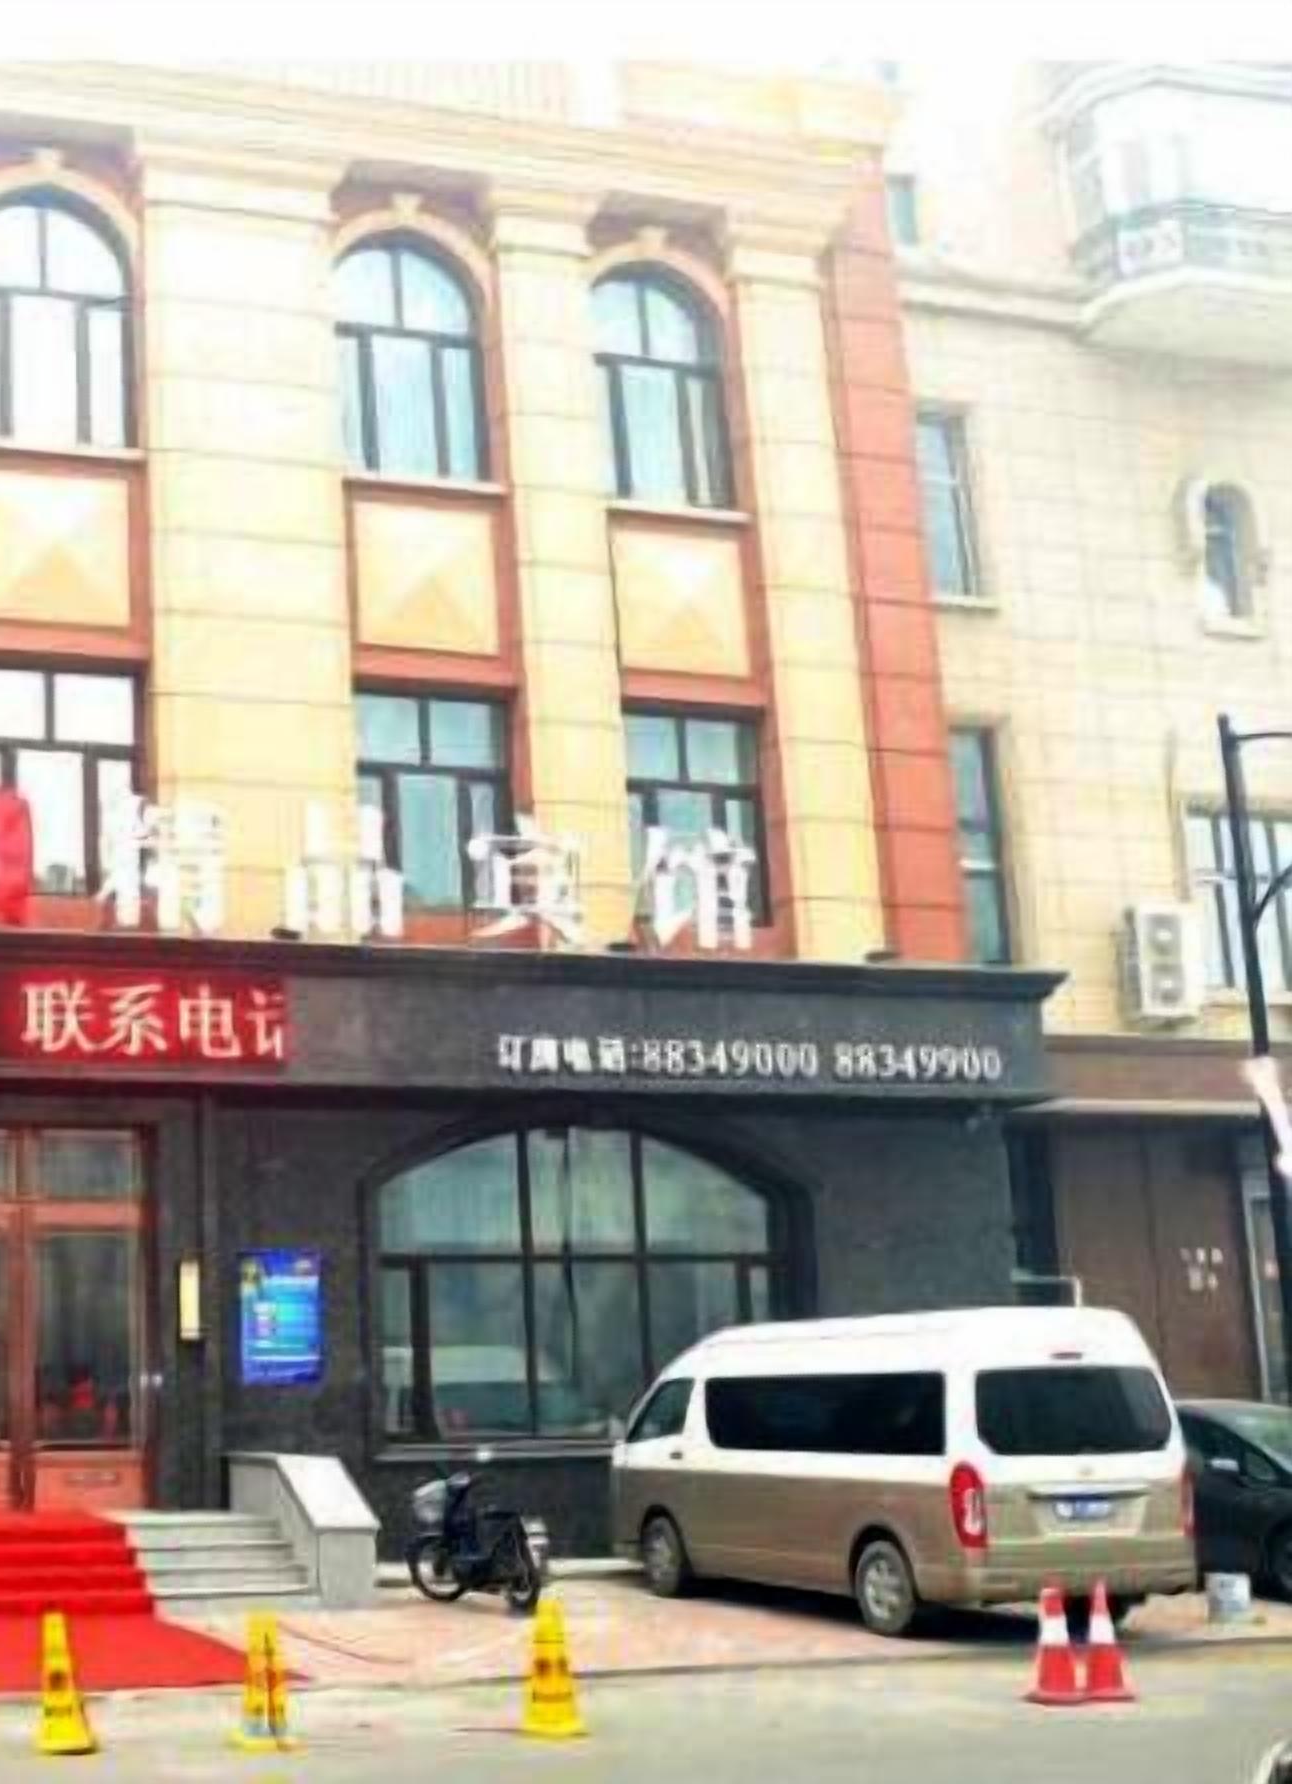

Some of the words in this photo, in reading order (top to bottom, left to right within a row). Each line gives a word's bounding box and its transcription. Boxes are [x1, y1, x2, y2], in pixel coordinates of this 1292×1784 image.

[96, 787, 757, 949] 精品宾馆
[834, 1043, 1002, 1079] 88349900
